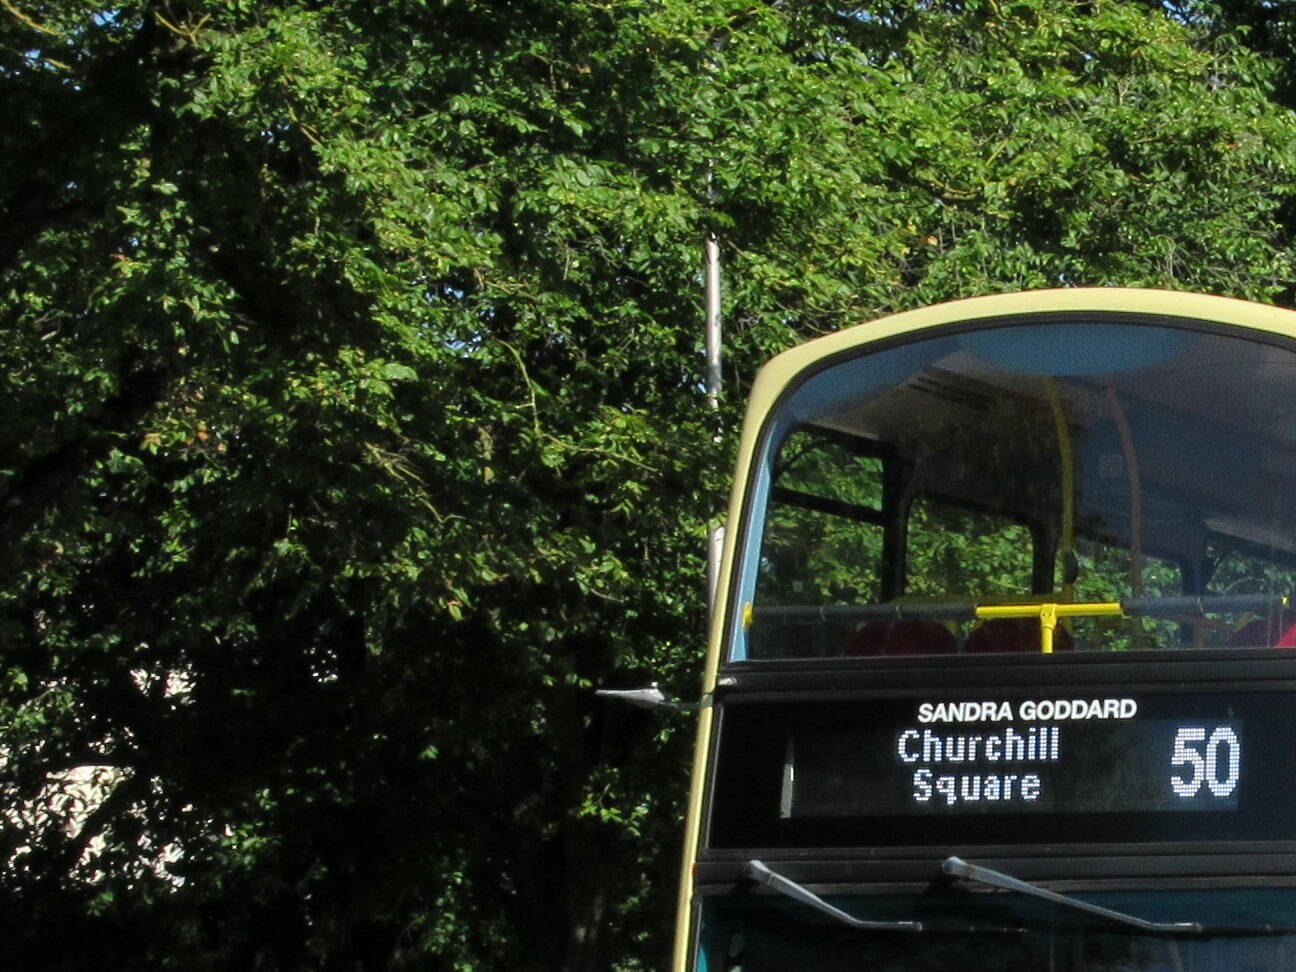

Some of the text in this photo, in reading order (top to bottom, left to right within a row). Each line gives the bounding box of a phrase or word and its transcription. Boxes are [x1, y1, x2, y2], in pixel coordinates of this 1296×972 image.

[918, 698, 1137, 723] SANDRA GODDARD
[898, 727, 1060, 762] Churchill
[1170, 726, 1240, 798] 50
[913, 769, 1041, 805] Square
